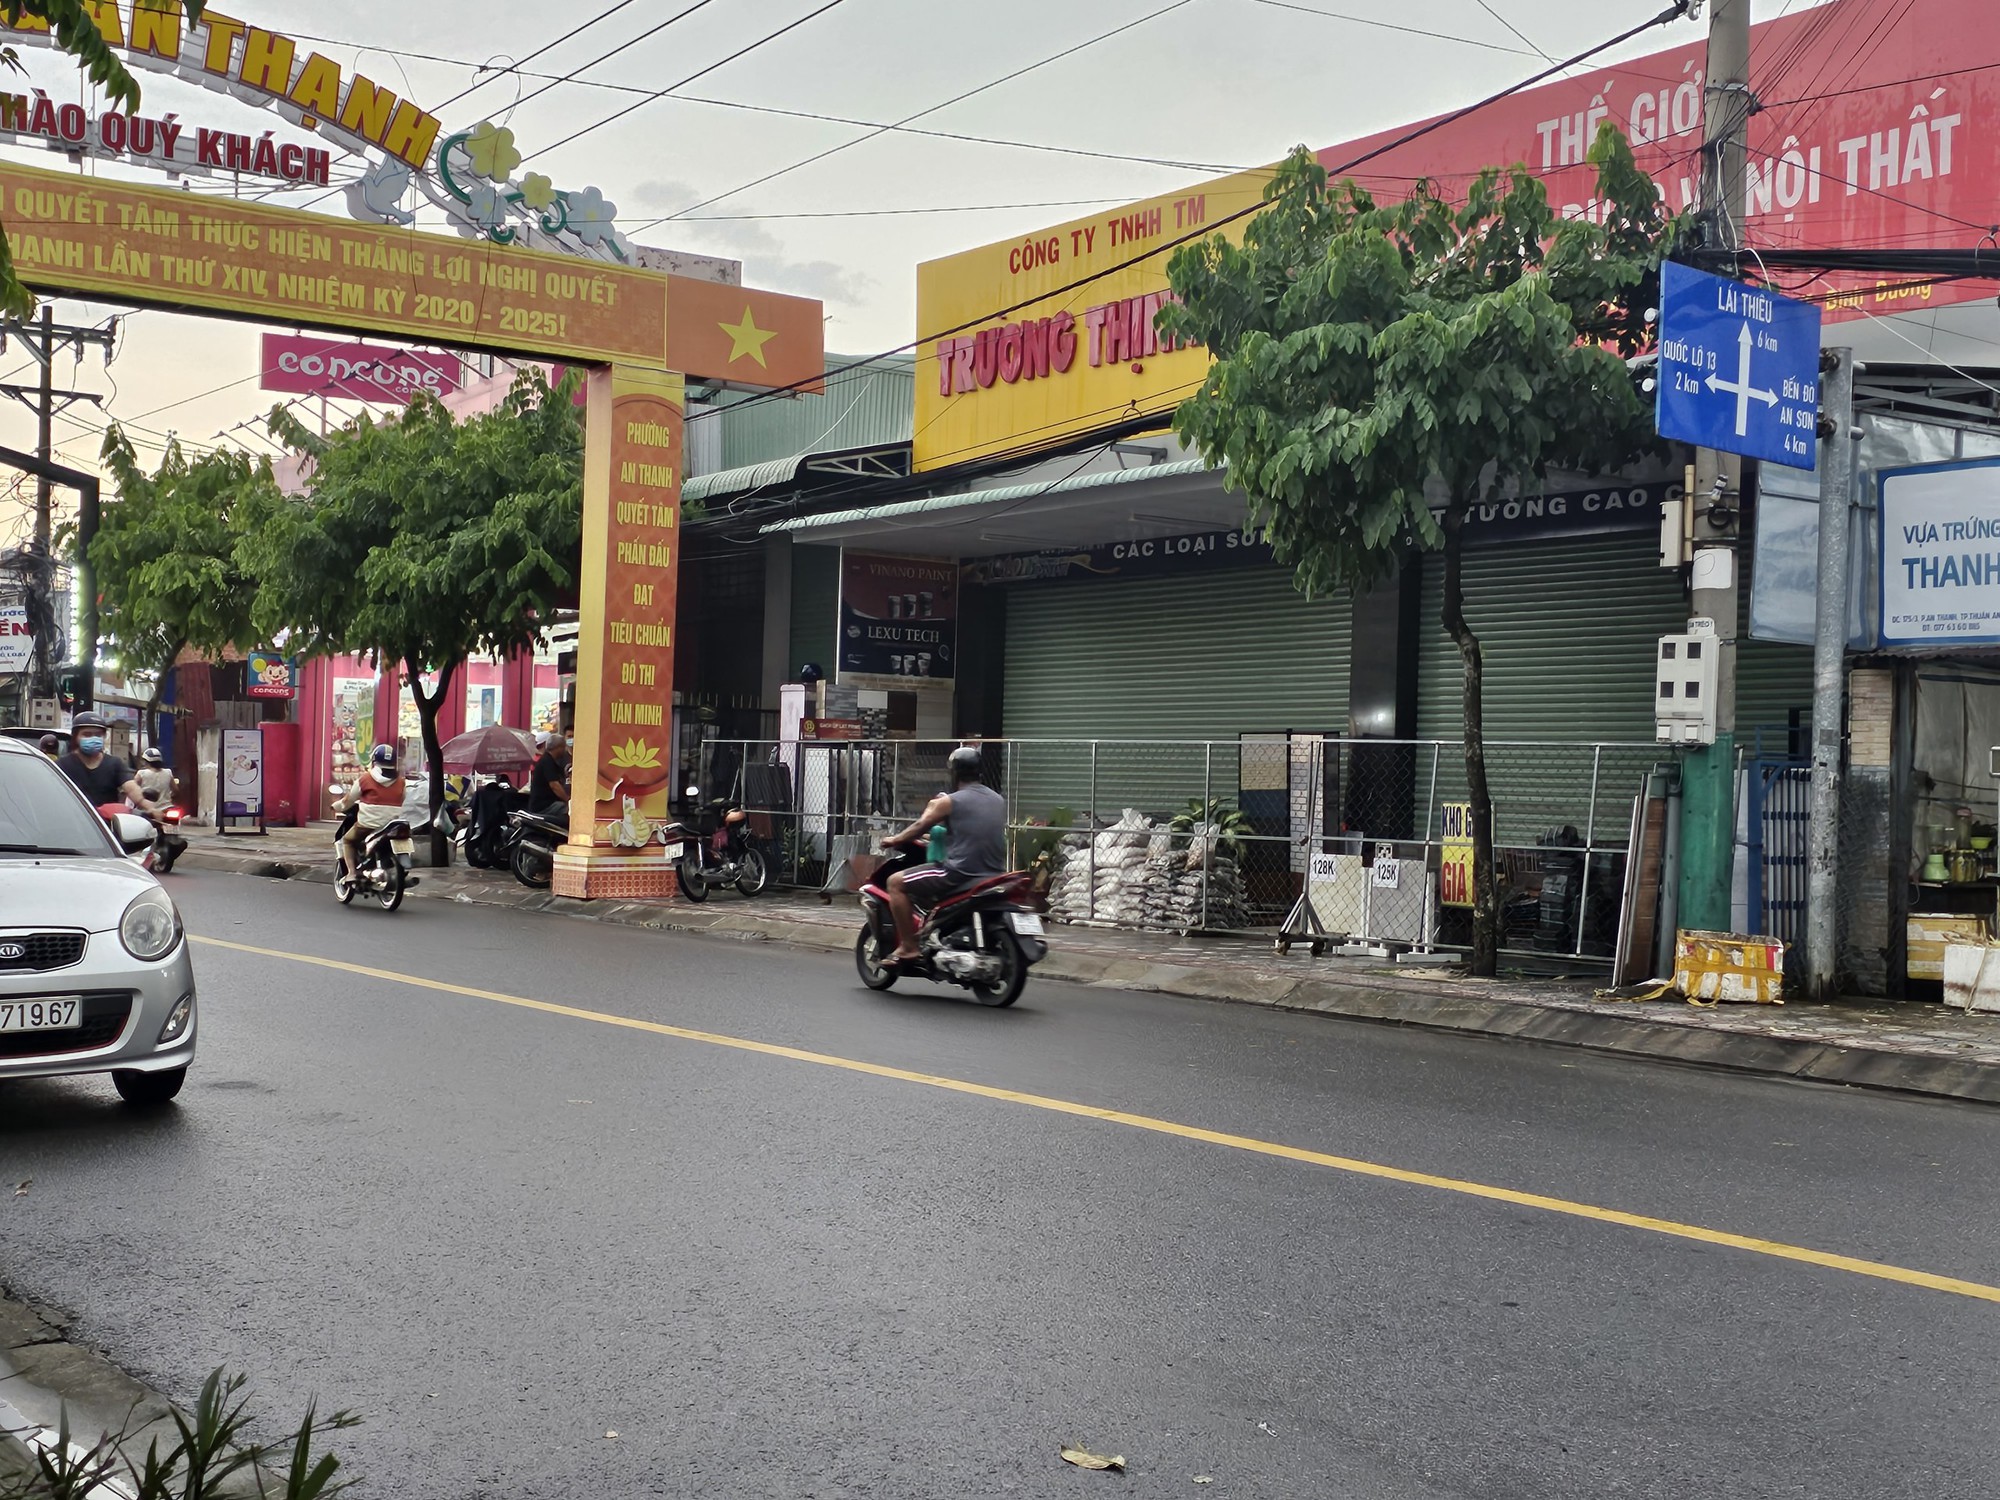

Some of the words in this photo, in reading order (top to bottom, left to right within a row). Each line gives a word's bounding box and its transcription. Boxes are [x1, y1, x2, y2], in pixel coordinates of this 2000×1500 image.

[200, 8, 441, 171] THẠNH
[1536, 79, 1616, 172] THẾ
[1630, 58, 1704, 147] GIỚ
[100, 112, 184, 157] QUÝ
[196, 127, 331, 187] KHÁCH
[1744, 134, 1821, 223] NỘI
[1838, 87, 1961, 197] THẤT
[14, 187, 109, 225] QUYẾT
[116, 202, 180, 239] TÂM
[187, 214, 260, 253] THỰC
[268, 226, 332, 264] HIỆN
[339, 239, 425, 277] THẮNG
[432, 256, 471, 285] LỢI
[480, 262, 538, 296] NGHỊ
[545, 273, 619, 307] QUYẾT
[1008, 237, 1060, 275] CÔNG
[1070, 225, 1097, 258] TY
[1108, 206, 1162, 248] TNHH
[1173, 194, 1207, 230] TM
[94, 239, 151, 279] LẦN
[159, 256, 218, 288] THỨ
[279, 271, 366, 311] NHIỆM
[373, 285, 407, 316] KỲ
[413, 293, 476, 325] 2020
[499, 306, 567, 338] 2025!
[1718, 283, 1737, 314] LÁI
[1741, 292, 1773, 324] THIÊU
[1084, 289, 1206, 376] THỊN
[1757, 330, 1764, 348] 6
[1764, 331, 1779, 353] km
[1663, 337, 1688, 364] QUỐC
[1691, 344, 1704, 371] LỘ
[1706, 351, 1717, 371] 13
[1675, 371, 1682, 391] 2
[1684, 372, 1700, 395] km
[1782, 374, 1800, 400] BẾN
[626, 419, 671, 448] PHƯỜNG
[1780, 406, 1793, 426] AN
[1796, 409, 1815, 430] SƠN
[1784, 434, 1790, 452] 4
[1792, 434, 1807, 455] km
[620, 461, 636, 484] AN
[638, 463, 673, 491] THẠNH
[616, 497, 650, 526] QUYẾT
[651, 501, 674, 529] TÂM
[1582, 489, 1649, 512] CAO
[1113, 537, 1155, 561] CÁC
[1164, 533, 1216, 556] LOẠI
[1902, 520, 1940, 549] VỰA
[1941, 515, 2000, 542] TRỨNG
[617, 535, 647, 566] PHẤN
[648, 538, 671, 568] ĐẤU
[869, 563, 916, 579] VINANO
[917, 568, 953, 582] PAINT
[1901, 552, 2000, 590] THANH
[633, 583, 655, 610] ĐẠT
[867, 625, 902, 640] LEXU
[905, 628, 940, 643] TECH
[621, 659, 637, 685] ĐÔ
[639, 663, 656, 690] THỊ
[610, 698, 632, 725] VĂN
[634, 703, 663, 726] MINH
[1442, 806, 1461, 838] KHO
[1313, 859, 1335, 876] 128K
[1378, 864, 1398, 881] 125K
[1442, 853, 1468, 904] GIÁ
[1, 1000, 77, 1029] 719.67
